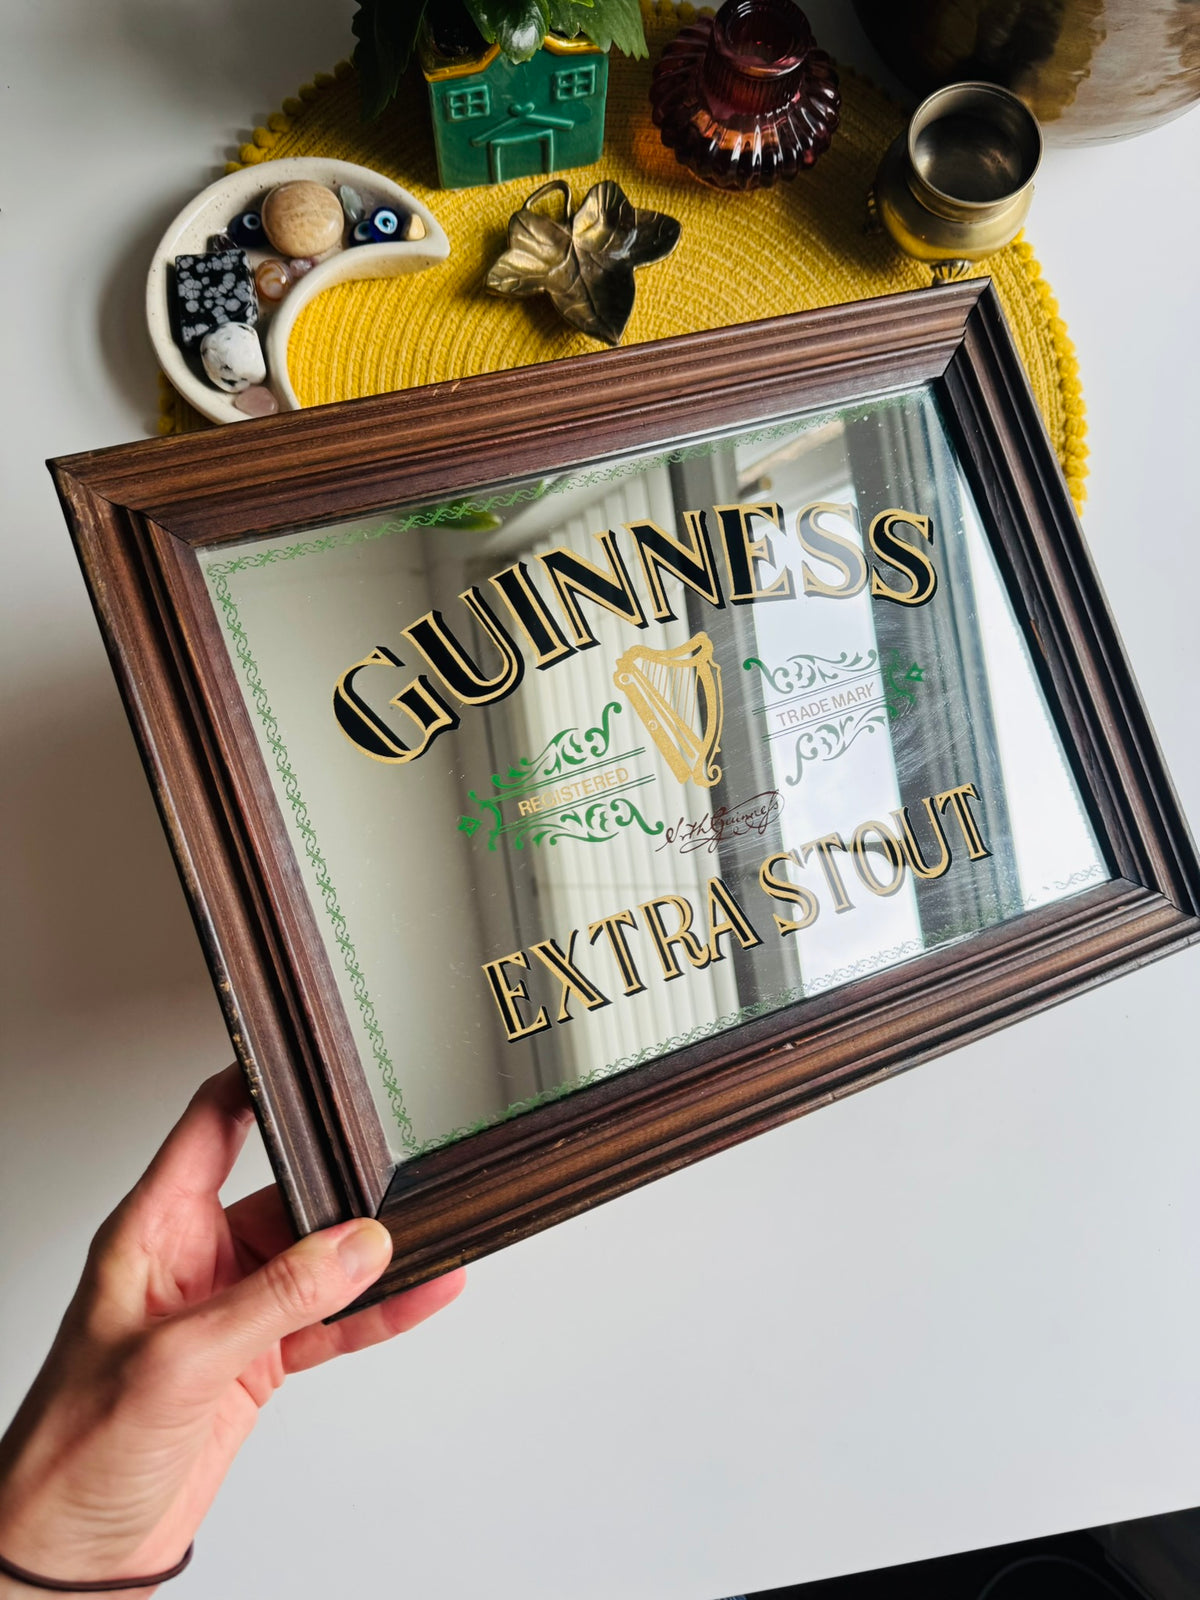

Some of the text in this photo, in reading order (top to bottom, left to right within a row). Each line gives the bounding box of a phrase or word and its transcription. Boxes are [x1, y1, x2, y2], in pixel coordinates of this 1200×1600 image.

[332, 502, 939, 764] GUINNESS
[776, 682, 874, 726] TRADE MARK
[518, 767, 629, 817] REGISTERED
[481, 782, 993, 1043] EXTRA STOUT
